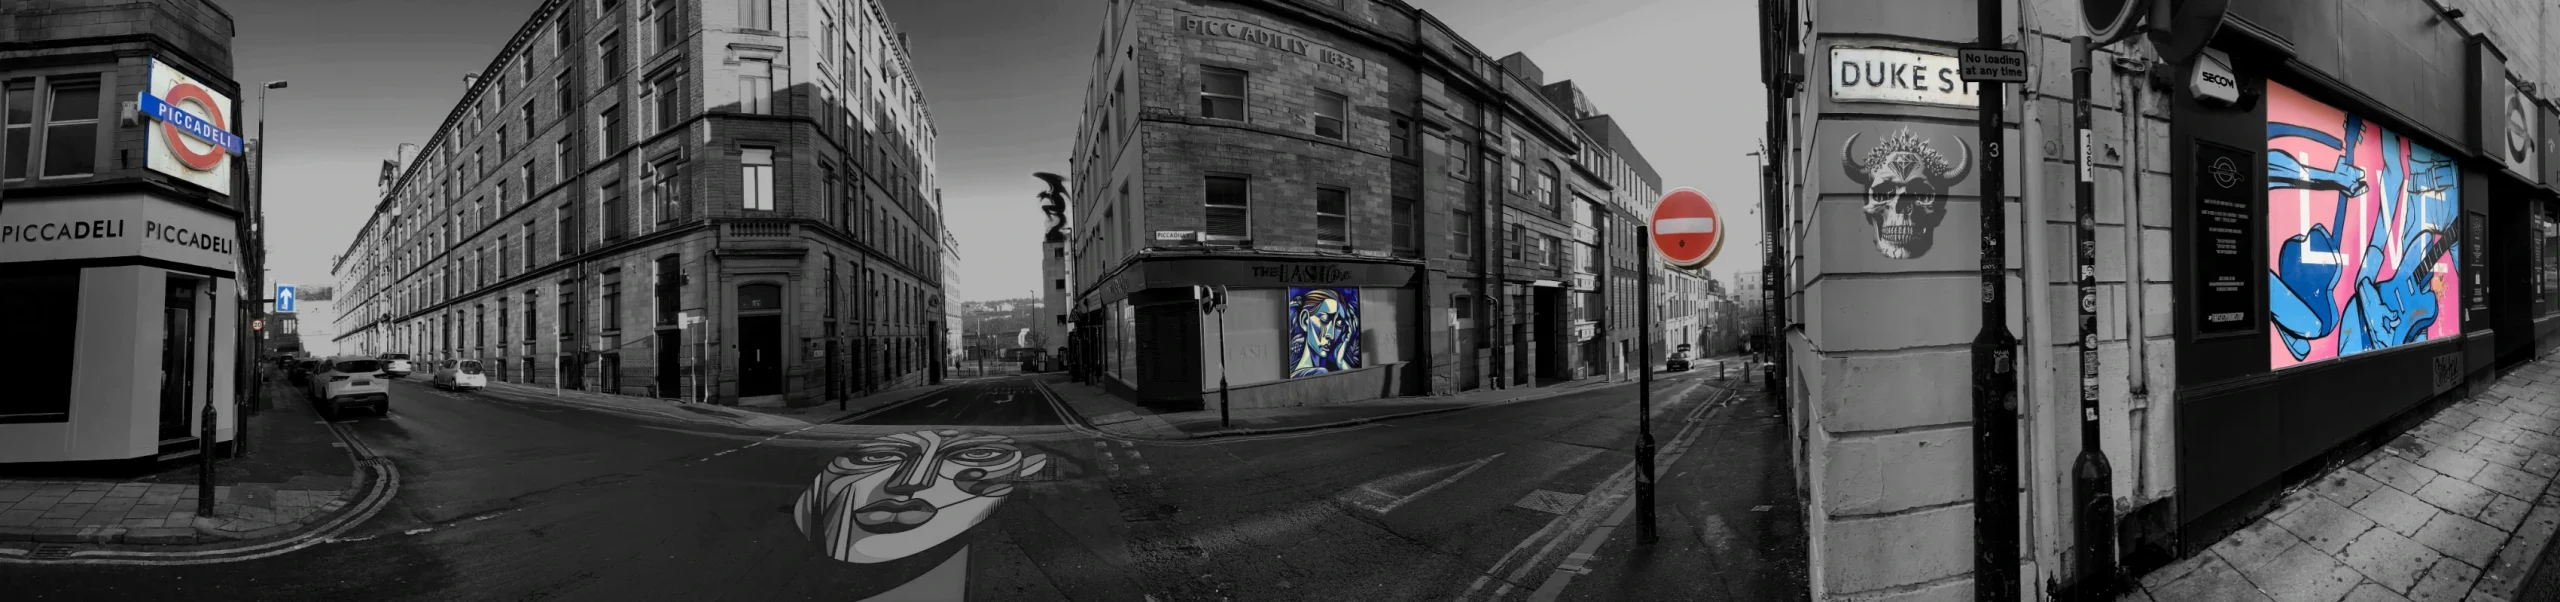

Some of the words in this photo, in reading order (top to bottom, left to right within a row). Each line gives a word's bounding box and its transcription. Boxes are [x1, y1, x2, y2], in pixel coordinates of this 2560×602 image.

[1180, 16, 1310, 57] PICCADILLY
[1965, 66, 1976, 75] at
[1980, 67, 1998, 77] any
[2001, 67, 2022, 77] time
[1966, 53, 1980, 63] No
[1984, 54, 2020, 66] loading
[1841, 61, 1927, 94] DUKE
[2202, 71, 2234, 89] SECOM
[159, 102, 231, 148] PICCADELI
[1989, 142, 1999, 157] 3
[2300, 150, 2448, 274] LIVE
[2, 219, 123, 243] PICCADELI
[147, 221, 232, 254] PICCADELI
[1252, 266, 1278, 277] THE
